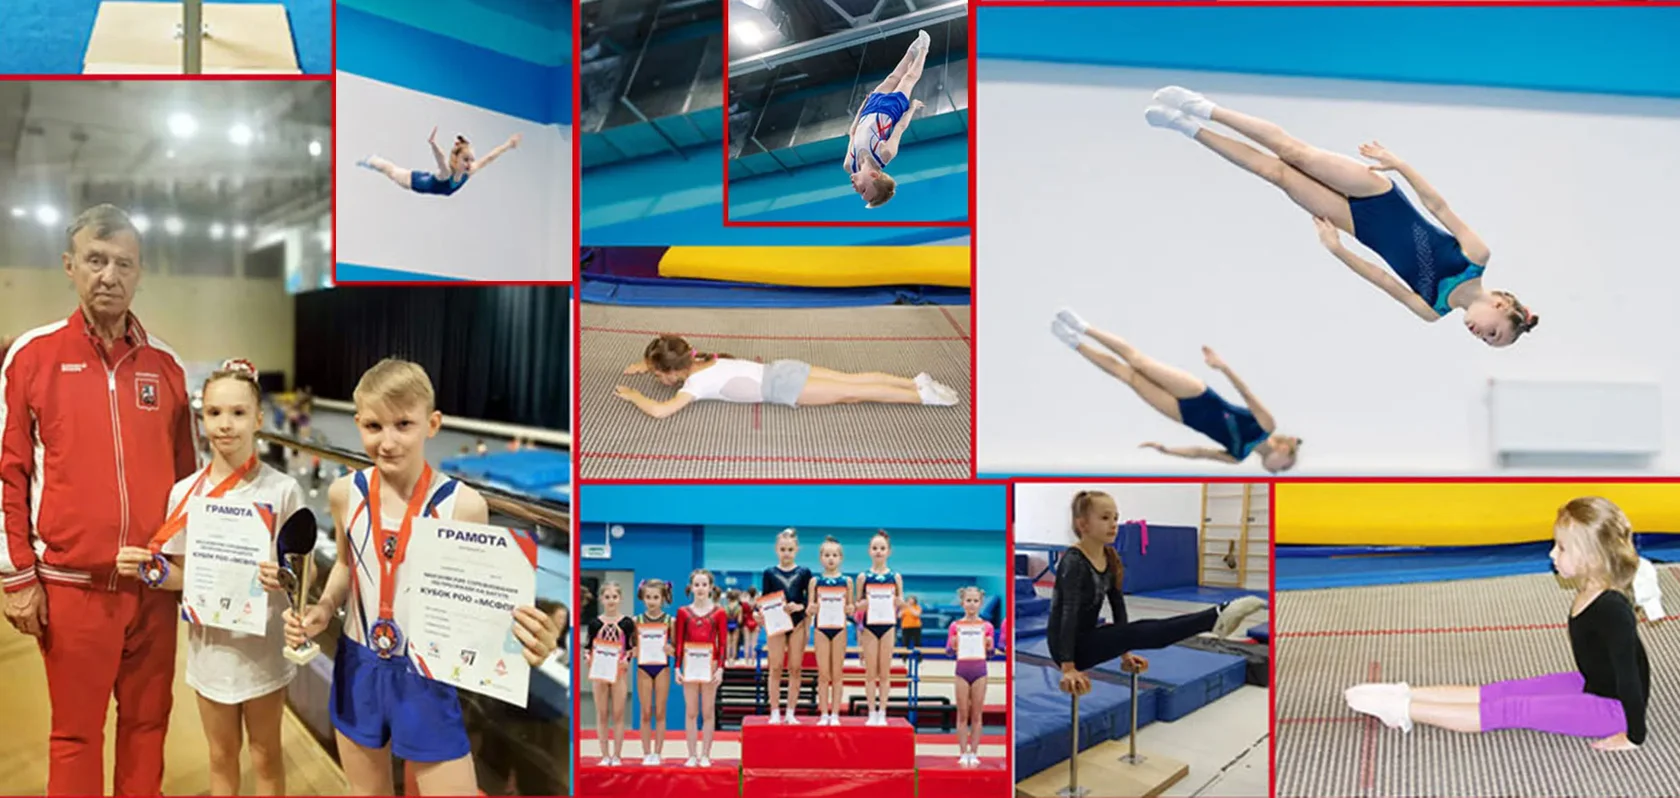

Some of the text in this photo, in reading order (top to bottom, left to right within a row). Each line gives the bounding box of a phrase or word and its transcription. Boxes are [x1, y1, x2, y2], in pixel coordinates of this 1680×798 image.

[205, 504, 253, 517] ГРАМОТА
[437, 528, 507, 548] ГРАМОТА
[420, 587, 451, 599] КУБОК
[452, 592, 473, 604] РОО
